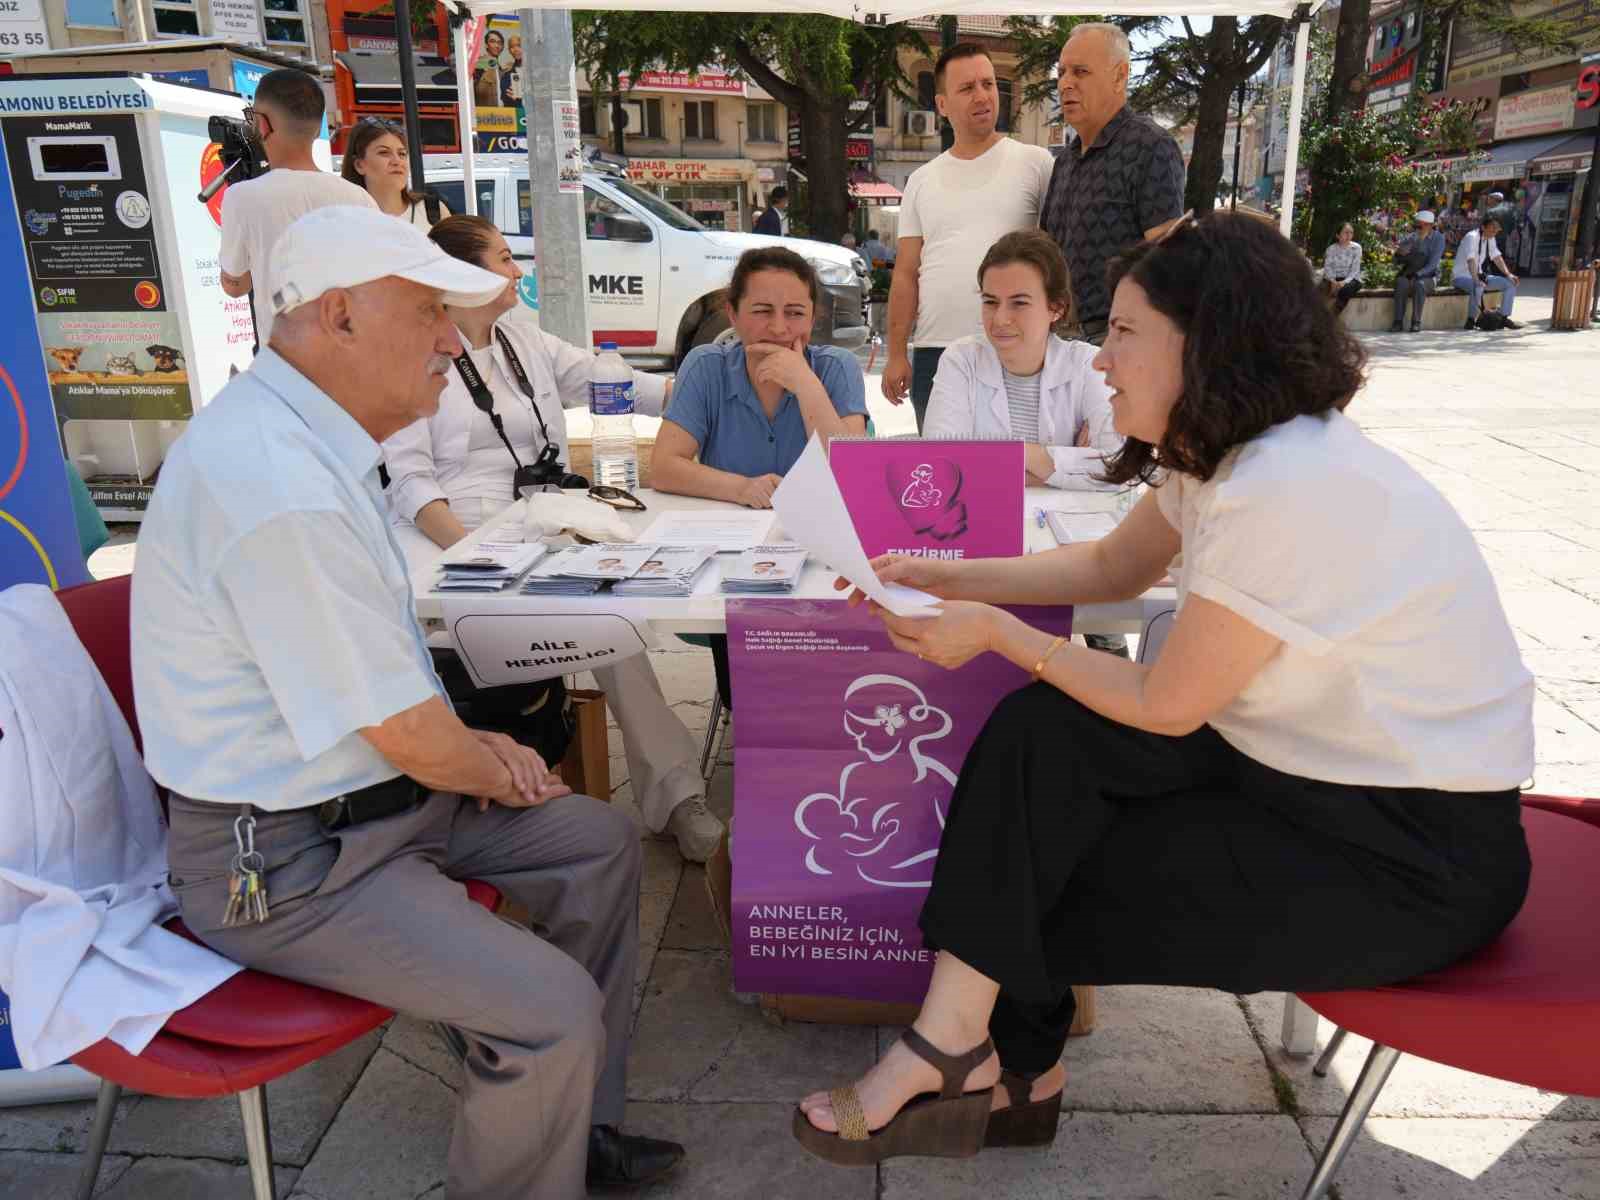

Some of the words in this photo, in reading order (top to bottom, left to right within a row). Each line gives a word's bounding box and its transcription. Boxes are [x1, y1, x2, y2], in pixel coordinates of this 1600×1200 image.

[0, 33, 19, 45] 63
[25, 33, 44, 45] 55
[58, 90, 148, 109] BELEDİYESİ
[45, 121, 93, 131] MamaMatik
[588, 274, 643, 295] MKE
[68, 386, 95, 396] Atıklar
[531, 640, 578, 652] AİLE
[748, 905, 848, 924] ANNELER,
[750, 924, 854, 942] BEBEĞİNİZ
[860, 926, 904, 946] İÇİN,
[750, 944, 776, 958] EN
[782, 943, 805, 959] İYİ
[811, 945, 868, 961] BESİN
[872, 950, 929, 962] ANNE
